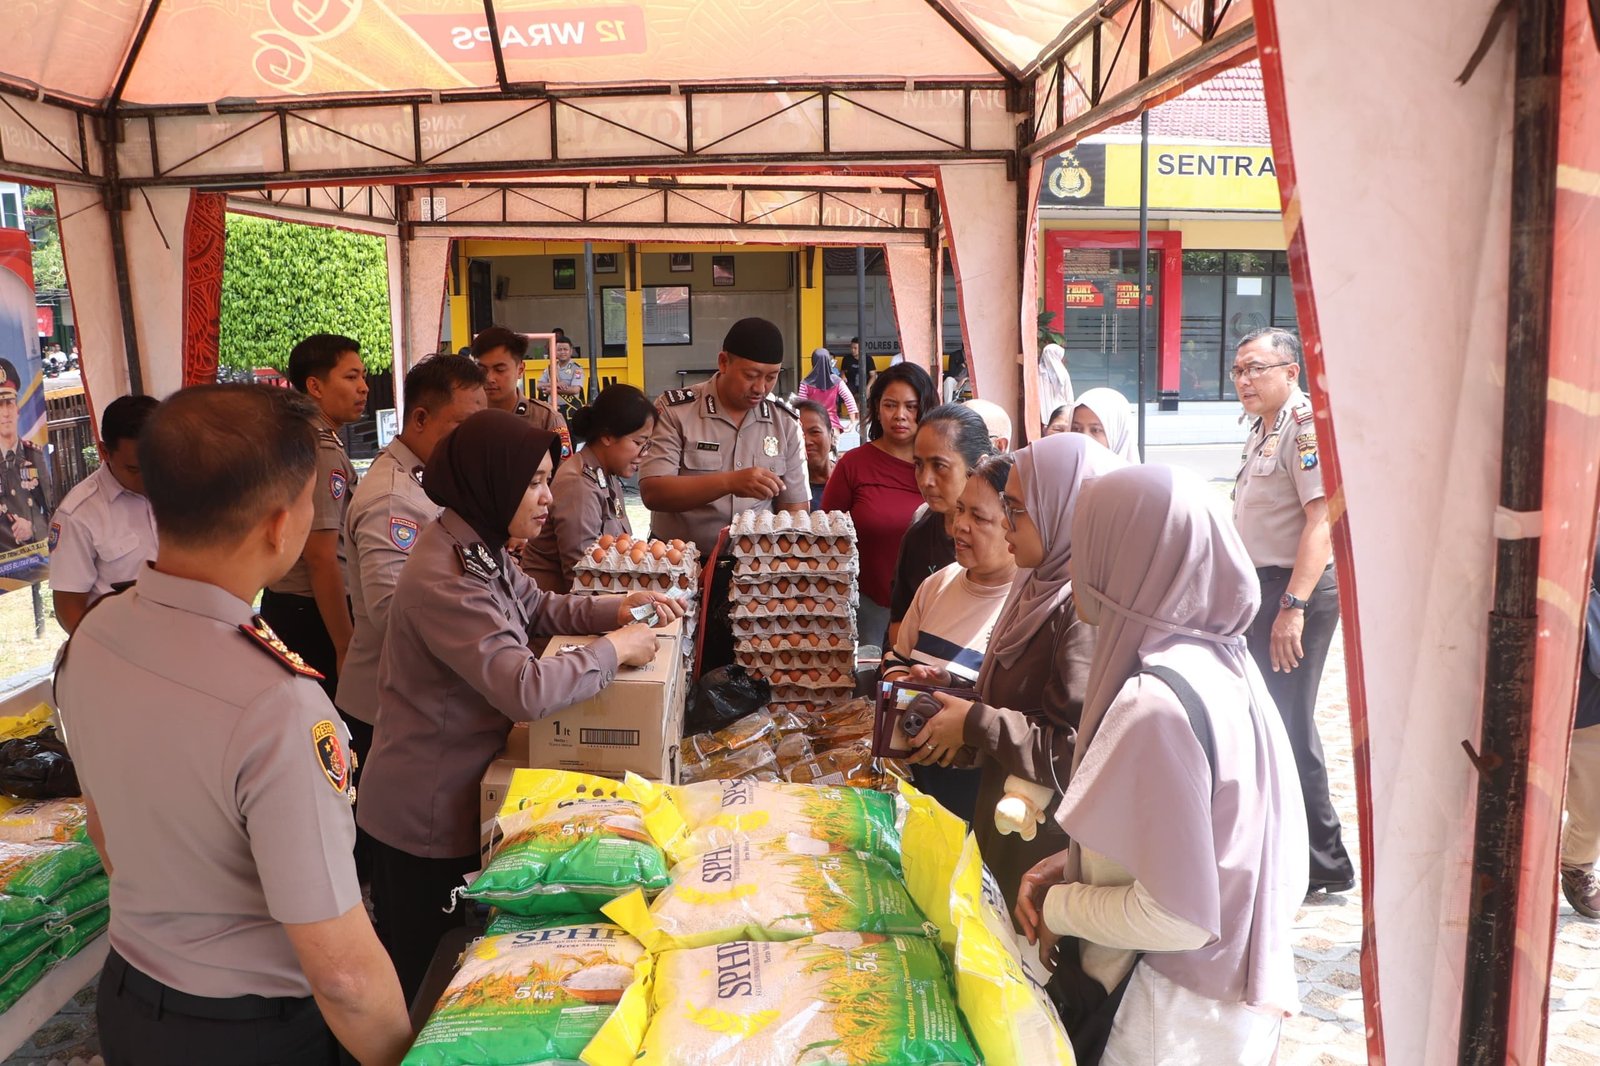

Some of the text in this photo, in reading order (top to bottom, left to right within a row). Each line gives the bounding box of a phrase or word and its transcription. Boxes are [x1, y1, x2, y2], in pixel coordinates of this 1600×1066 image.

[1157, 153, 1276, 177] SENTRA
[561, 823, 575, 836] 5
[701, 844, 733, 884] SPH
[511, 926, 631, 946] SPHP
[855, 960, 878, 974] 5
[514, 985, 530, 1000] 5
